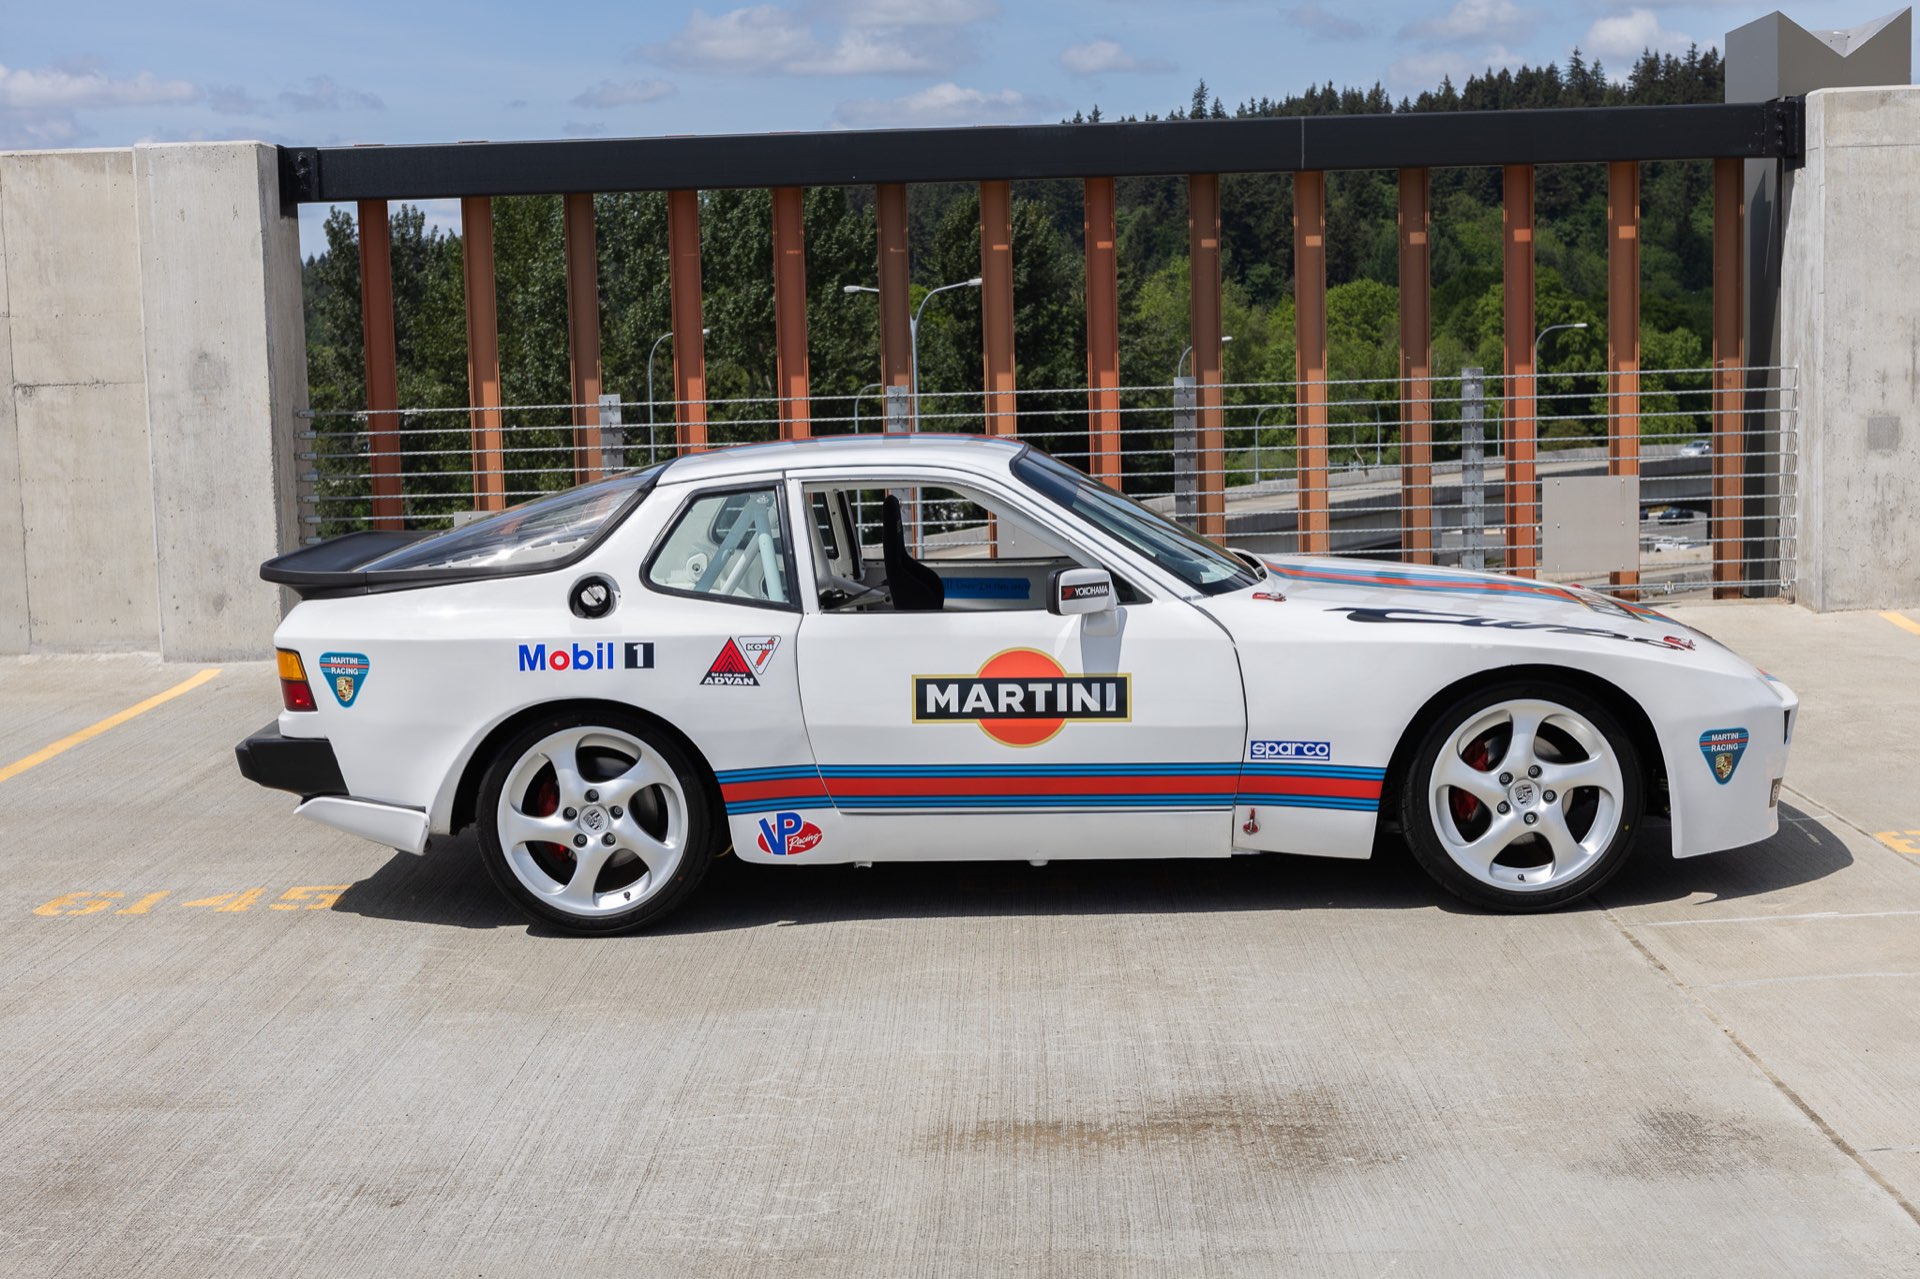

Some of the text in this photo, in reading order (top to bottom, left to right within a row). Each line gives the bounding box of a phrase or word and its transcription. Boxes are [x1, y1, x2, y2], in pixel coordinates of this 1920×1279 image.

[1075, 585, 1108, 596] YOKOHAMA
[746, 643, 773, 651] KONI
[330, 656, 358, 665] MARTINI
[518, 642, 613, 672] Mobil
[331, 667, 359, 675] RACING
[704, 677, 754, 685] ADVAN
[926, 682, 1117, 713] MARTINI
[1711, 732, 1739, 742] MARTINI
[1252, 742, 1329, 759] sparco
[1711, 743, 1738, 752] RACING
[758, 811, 803, 856] VP
[788, 833, 822, 851] Racing
